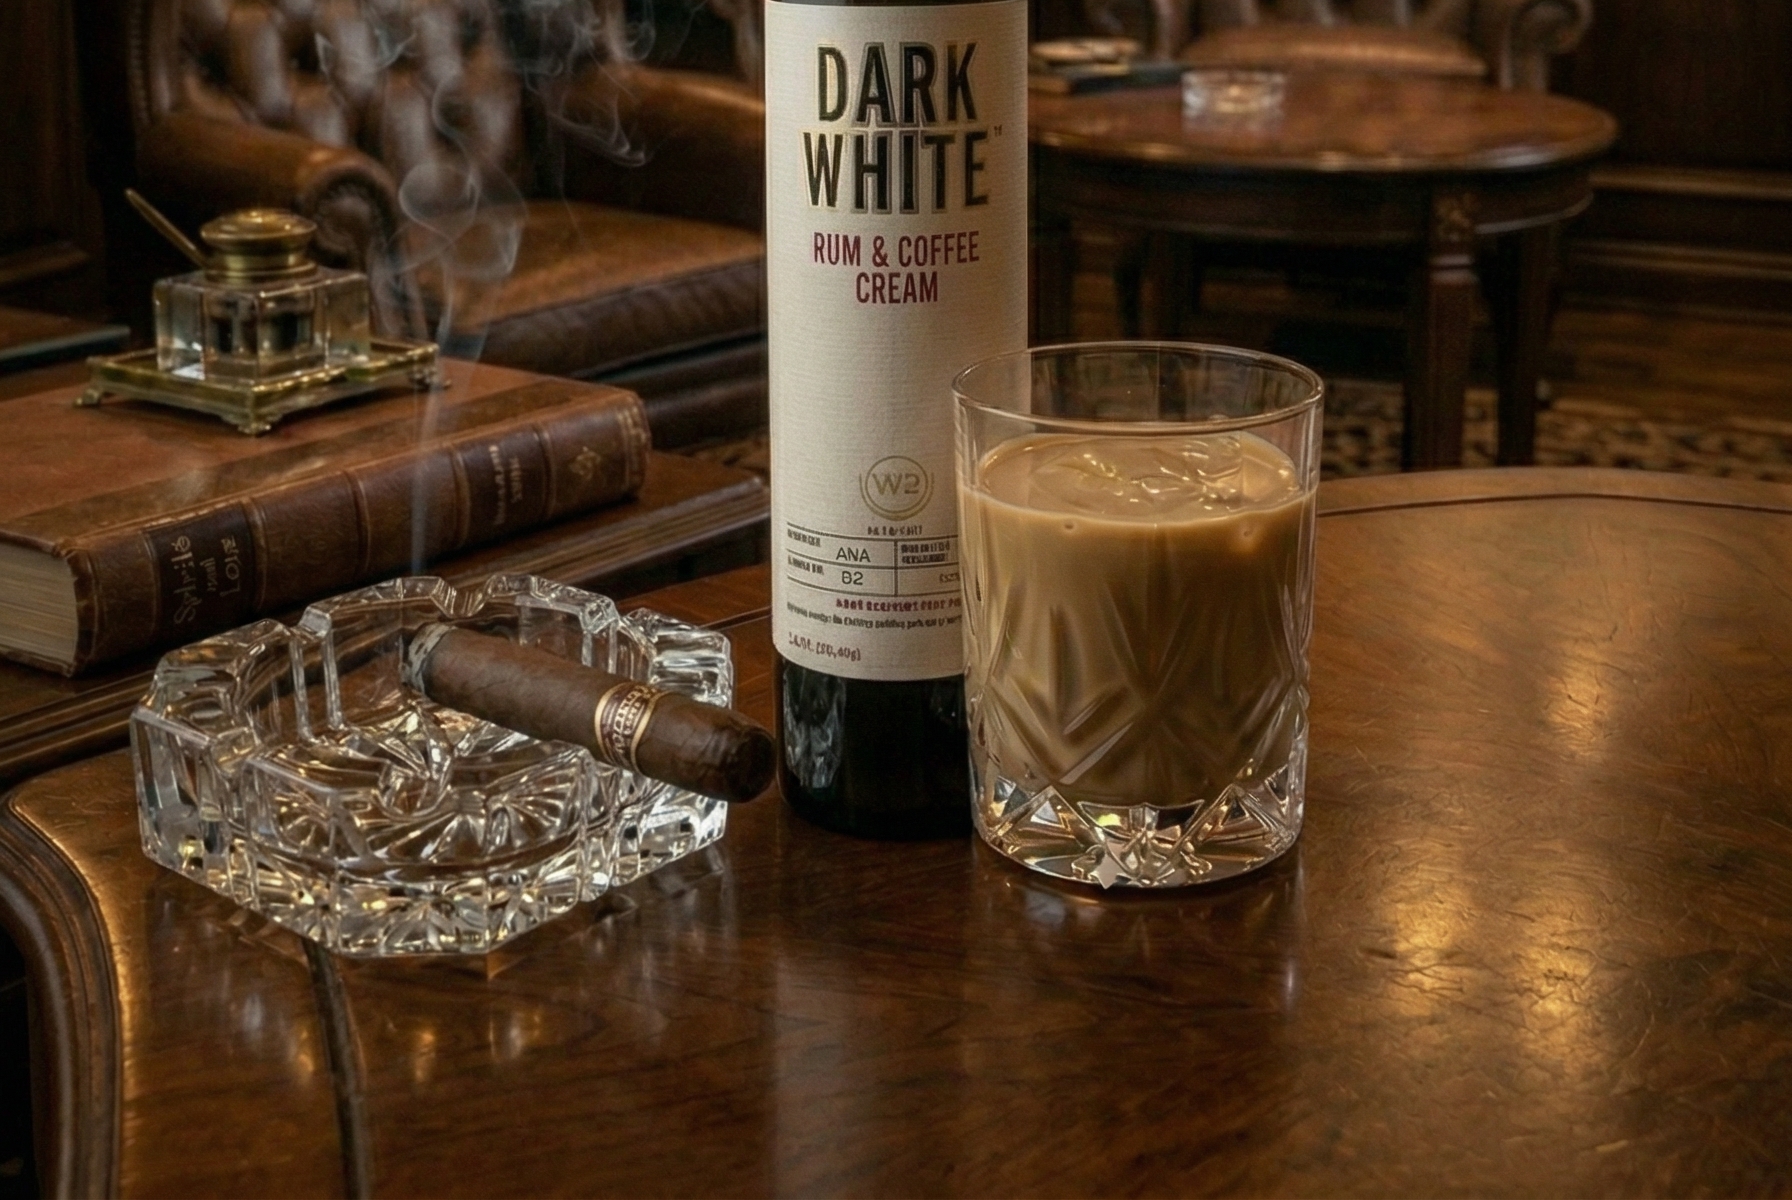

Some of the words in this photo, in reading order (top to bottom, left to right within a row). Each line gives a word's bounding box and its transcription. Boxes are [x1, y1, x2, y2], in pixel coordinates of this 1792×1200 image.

[817, 42, 977, 126] DARK
[803, 129, 989, 214] WHITE
[813, 231, 861, 267] RUM
[872, 235, 890, 268] &
[898, 230, 980, 267] COFFEE
[856, 271, 938, 304] CREAM
[835, 546, 871, 563] ANA
